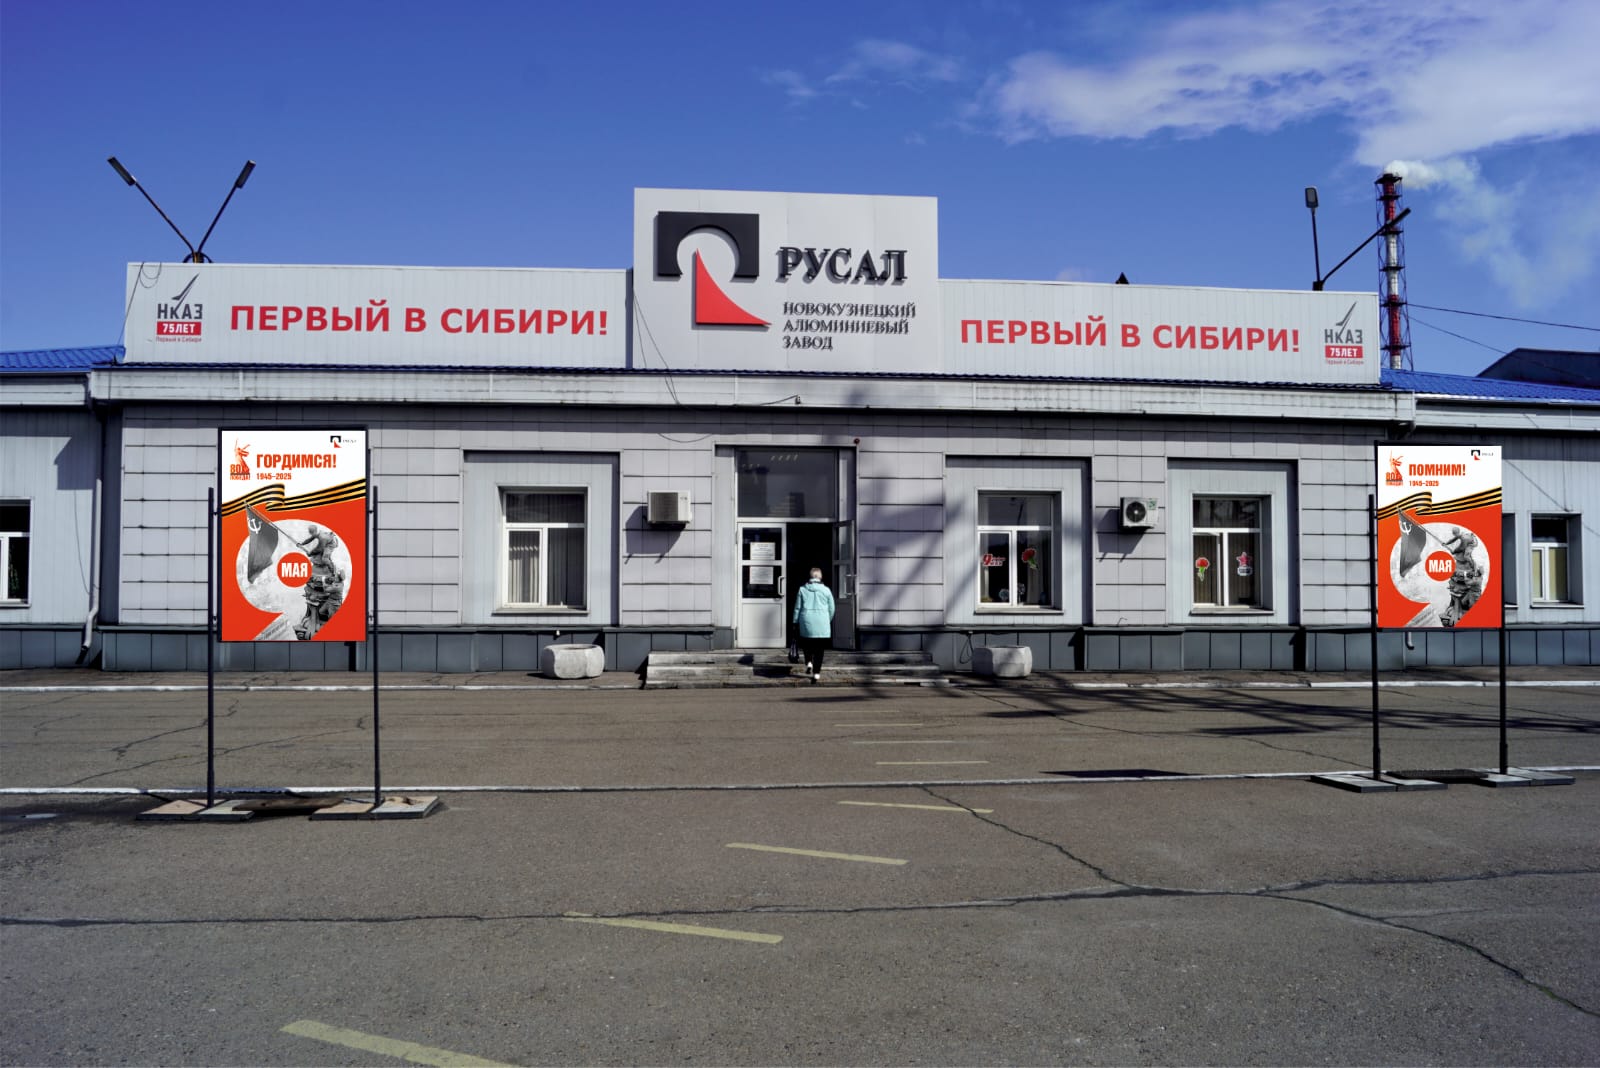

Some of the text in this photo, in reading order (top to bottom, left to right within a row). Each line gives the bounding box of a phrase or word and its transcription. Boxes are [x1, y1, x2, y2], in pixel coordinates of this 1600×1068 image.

[776, 246, 908, 285] РУСАЛ
[157, 303, 203, 320] НКАЗ
[231, 300, 608, 335] ПЕРВЫЙ В СИБИРИ!
[783, 302, 916, 320] НОВОКУЗНЕЦКИЙ
[783, 319, 909, 335] АЛЮМИНИЕВЫЙ
[961, 316, 1300, 353] ПЕРВЫЙ В СИБИРИ!
[783, 336, 833, 352] ЗАВОД
[1324, 329, 1363, 344] НКАЗ
[256, 454, 337, 470] ГОРДИМСЯ!
[1408, 463, 1466, 476] ПОМНИМ!
[281, 562, 309, 578] МАЯ
[1428, 559, 1453, 573] МАЯ
